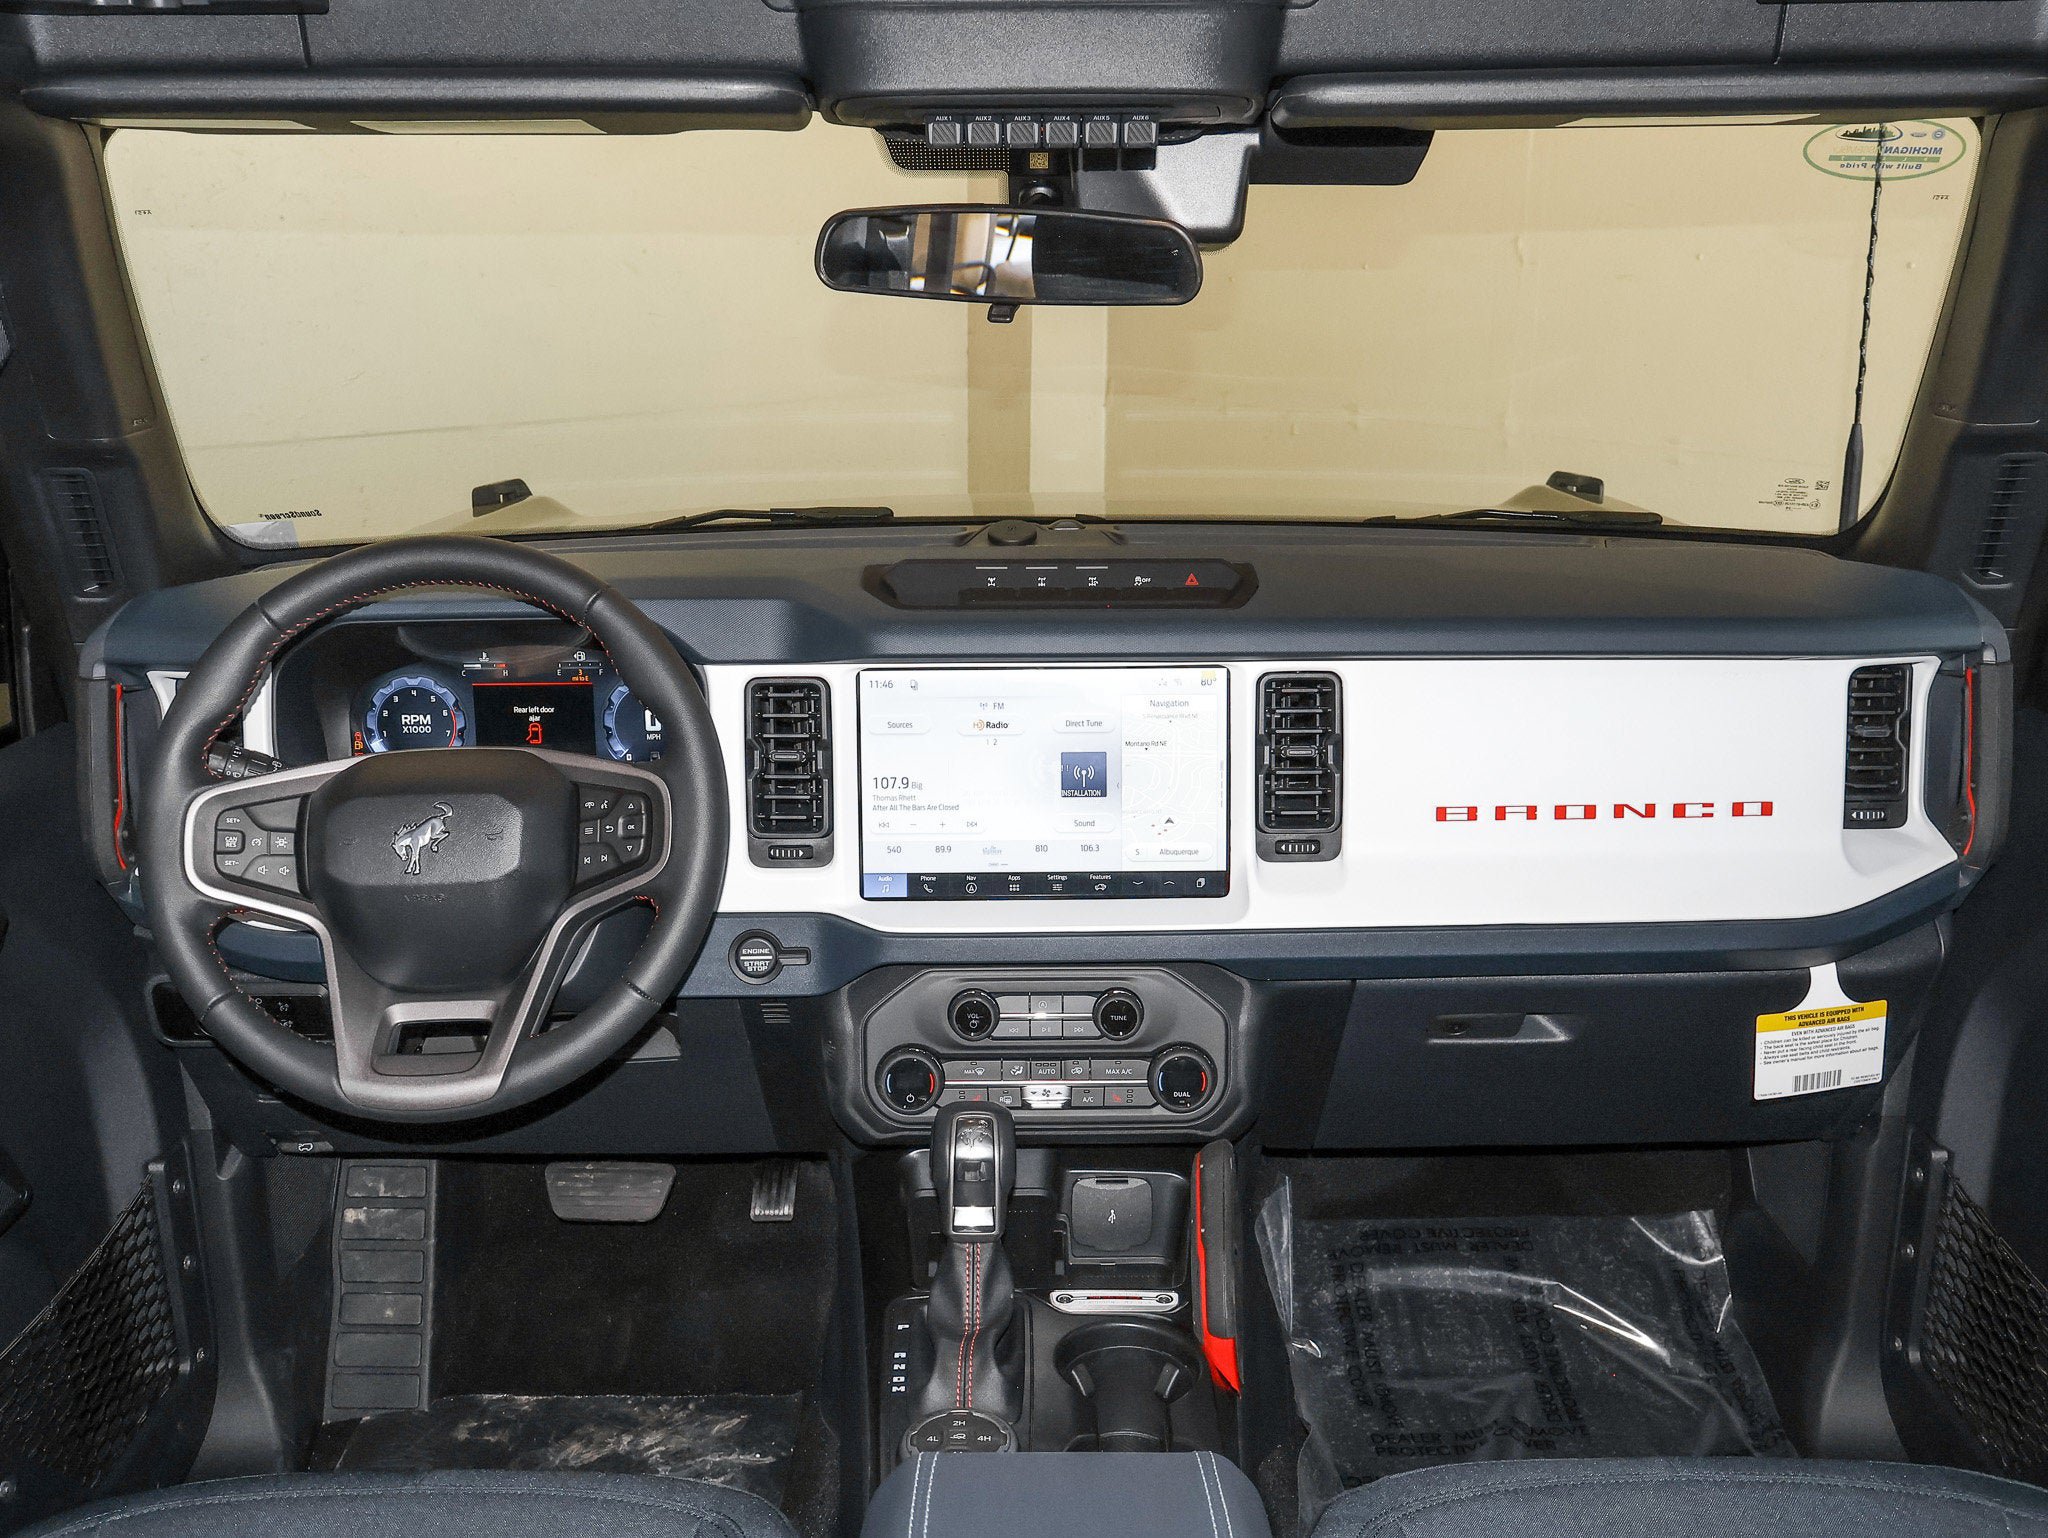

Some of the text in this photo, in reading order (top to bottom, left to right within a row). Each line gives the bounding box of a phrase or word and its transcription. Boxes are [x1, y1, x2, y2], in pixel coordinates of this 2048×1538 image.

[461, 669, 466, 677] C
[503, 669, 509, 677] H
[869, 680, 894, 689] 11:46
[1149, 700, 1189, 709] Navigation
[513, 706, 555, 714] Rear left door
[401, 714, 431, 725] RPM
[887, 721, 913, 729] Sources
[986, 721, 1008, 729] Radio
[1065, 720, 1103, 728] Direct Tune
[402, 725, 432, 734] X1000
[873, 777, 923, 790] 107.9 Big
[1061, 789, 1101, 797] INSTALLATION
[1435, 801, 1773, 821] BRONCO
[1074, 819, 1095, 827] Sound
[887, 846, 902, 854] 540
[935, 845, 952, 853] 89.9
[1035, 845, 1049, 853] 810
[1080, 844, 1100, 852] 106.3
[1159, 848, 1199, 857] Albuquerque
[1007, 875, 1021, 883] Apps
[1047, 874, 1068, 882] Settings
[1798, 1012, 1818, 1020] VEHICLE
[1798, 1019, 1826, 1027] ADVANCED
[891, 1385, 906, 1393] M
